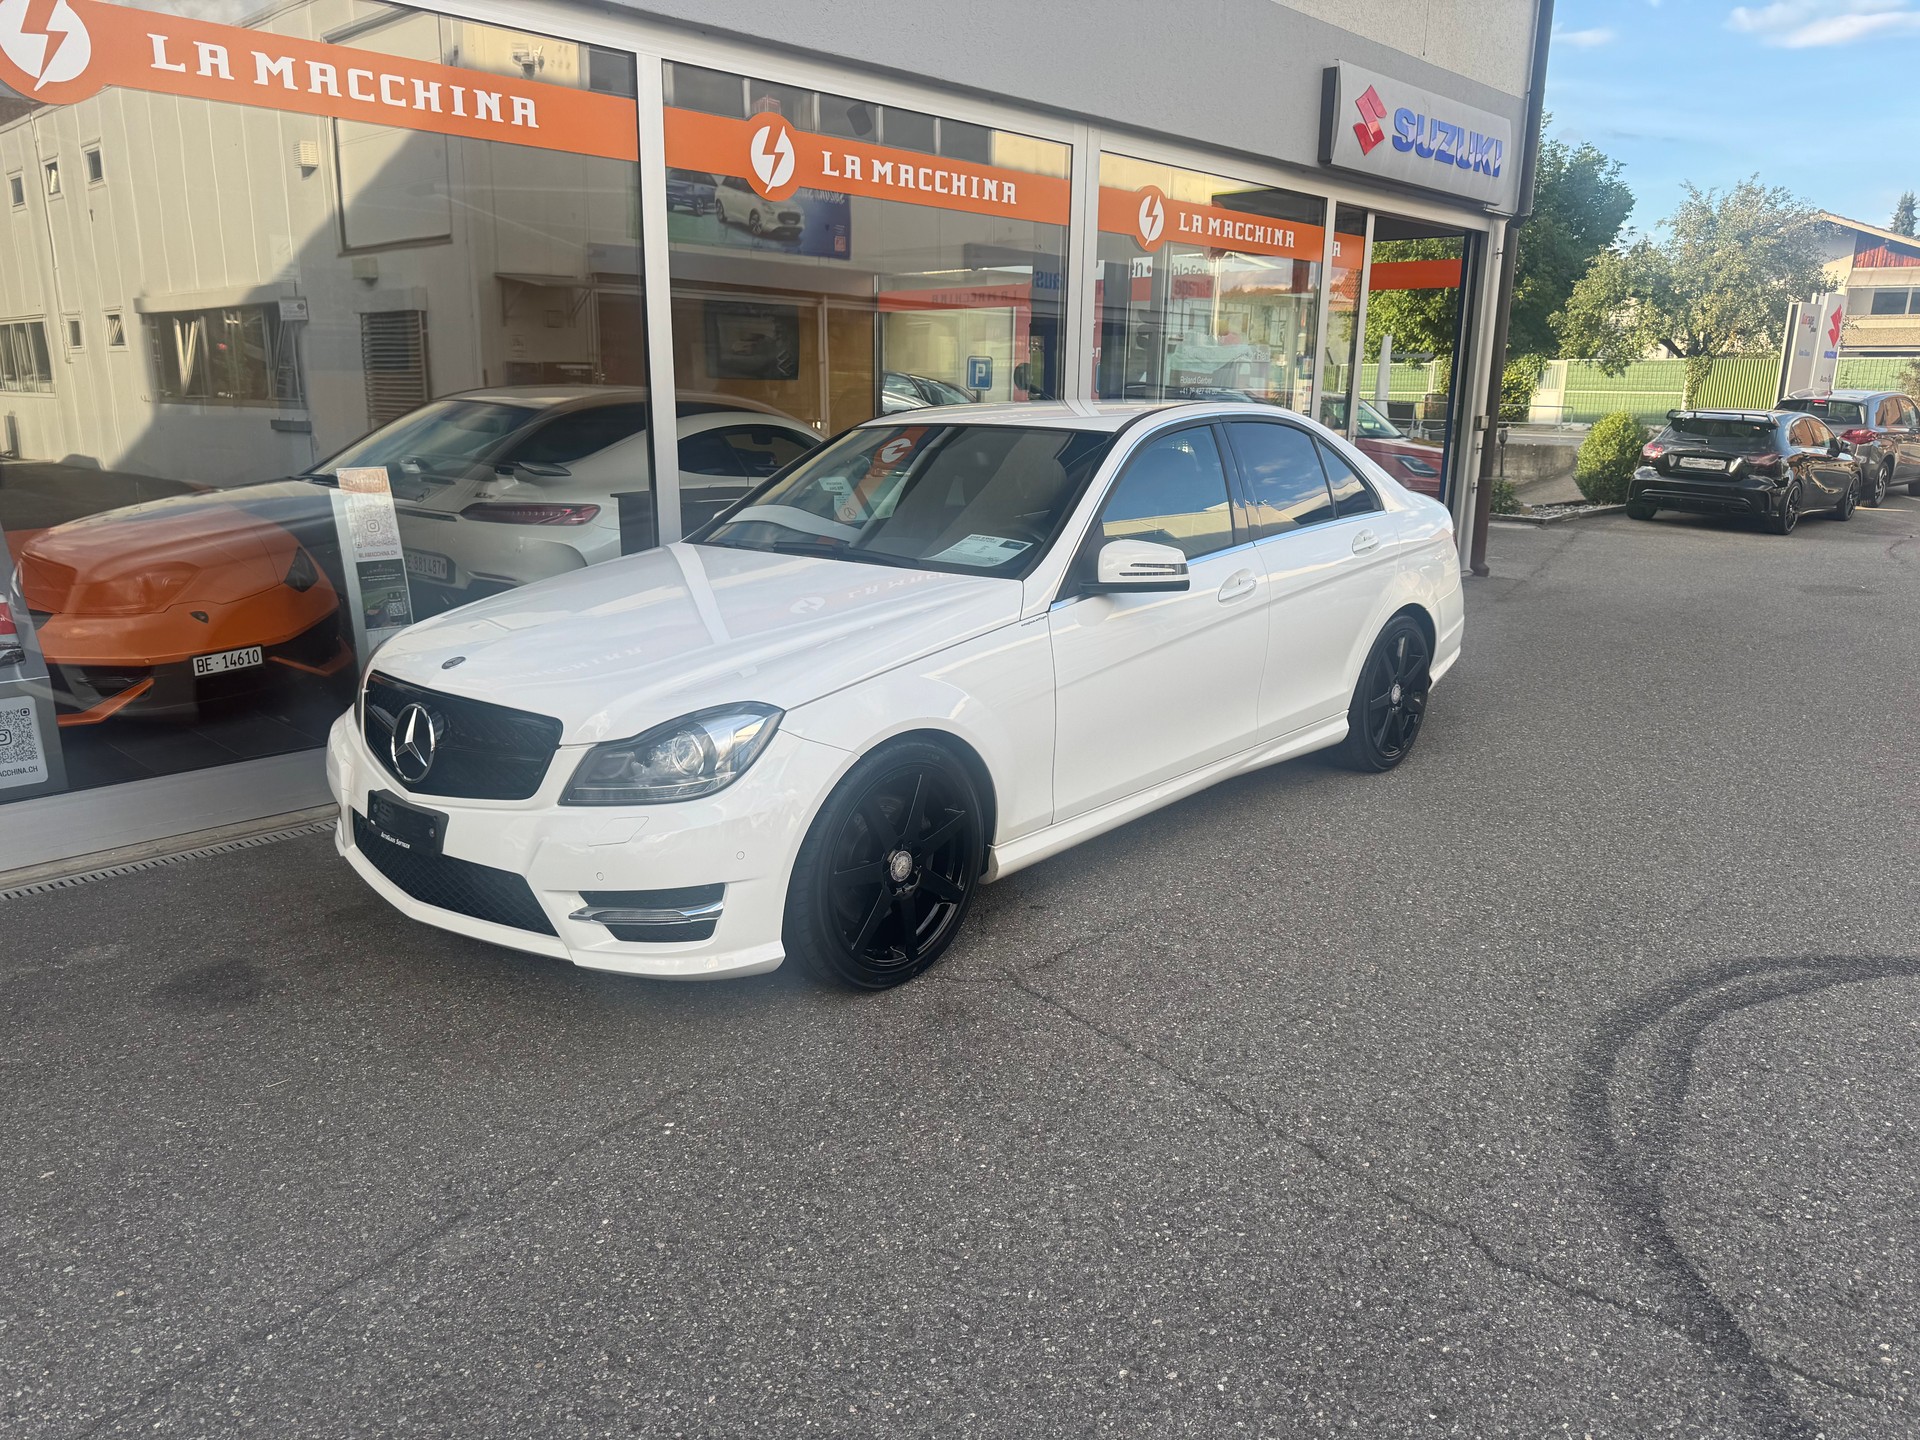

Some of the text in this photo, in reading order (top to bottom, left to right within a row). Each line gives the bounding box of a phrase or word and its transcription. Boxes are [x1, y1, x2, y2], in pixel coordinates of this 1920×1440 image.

[147, 33, 540, 129] LA MACCHINA
[1392, 107, 1503, 178] SUZUKI
[821, 150, 863, 181] LA
[871, 159, 1018, 205] MACCHINA
[1178, 212, 1296, 248] LA MACCHINA
[975, 363, 986, 385] P
[221, 649, 260, 668] 14610
